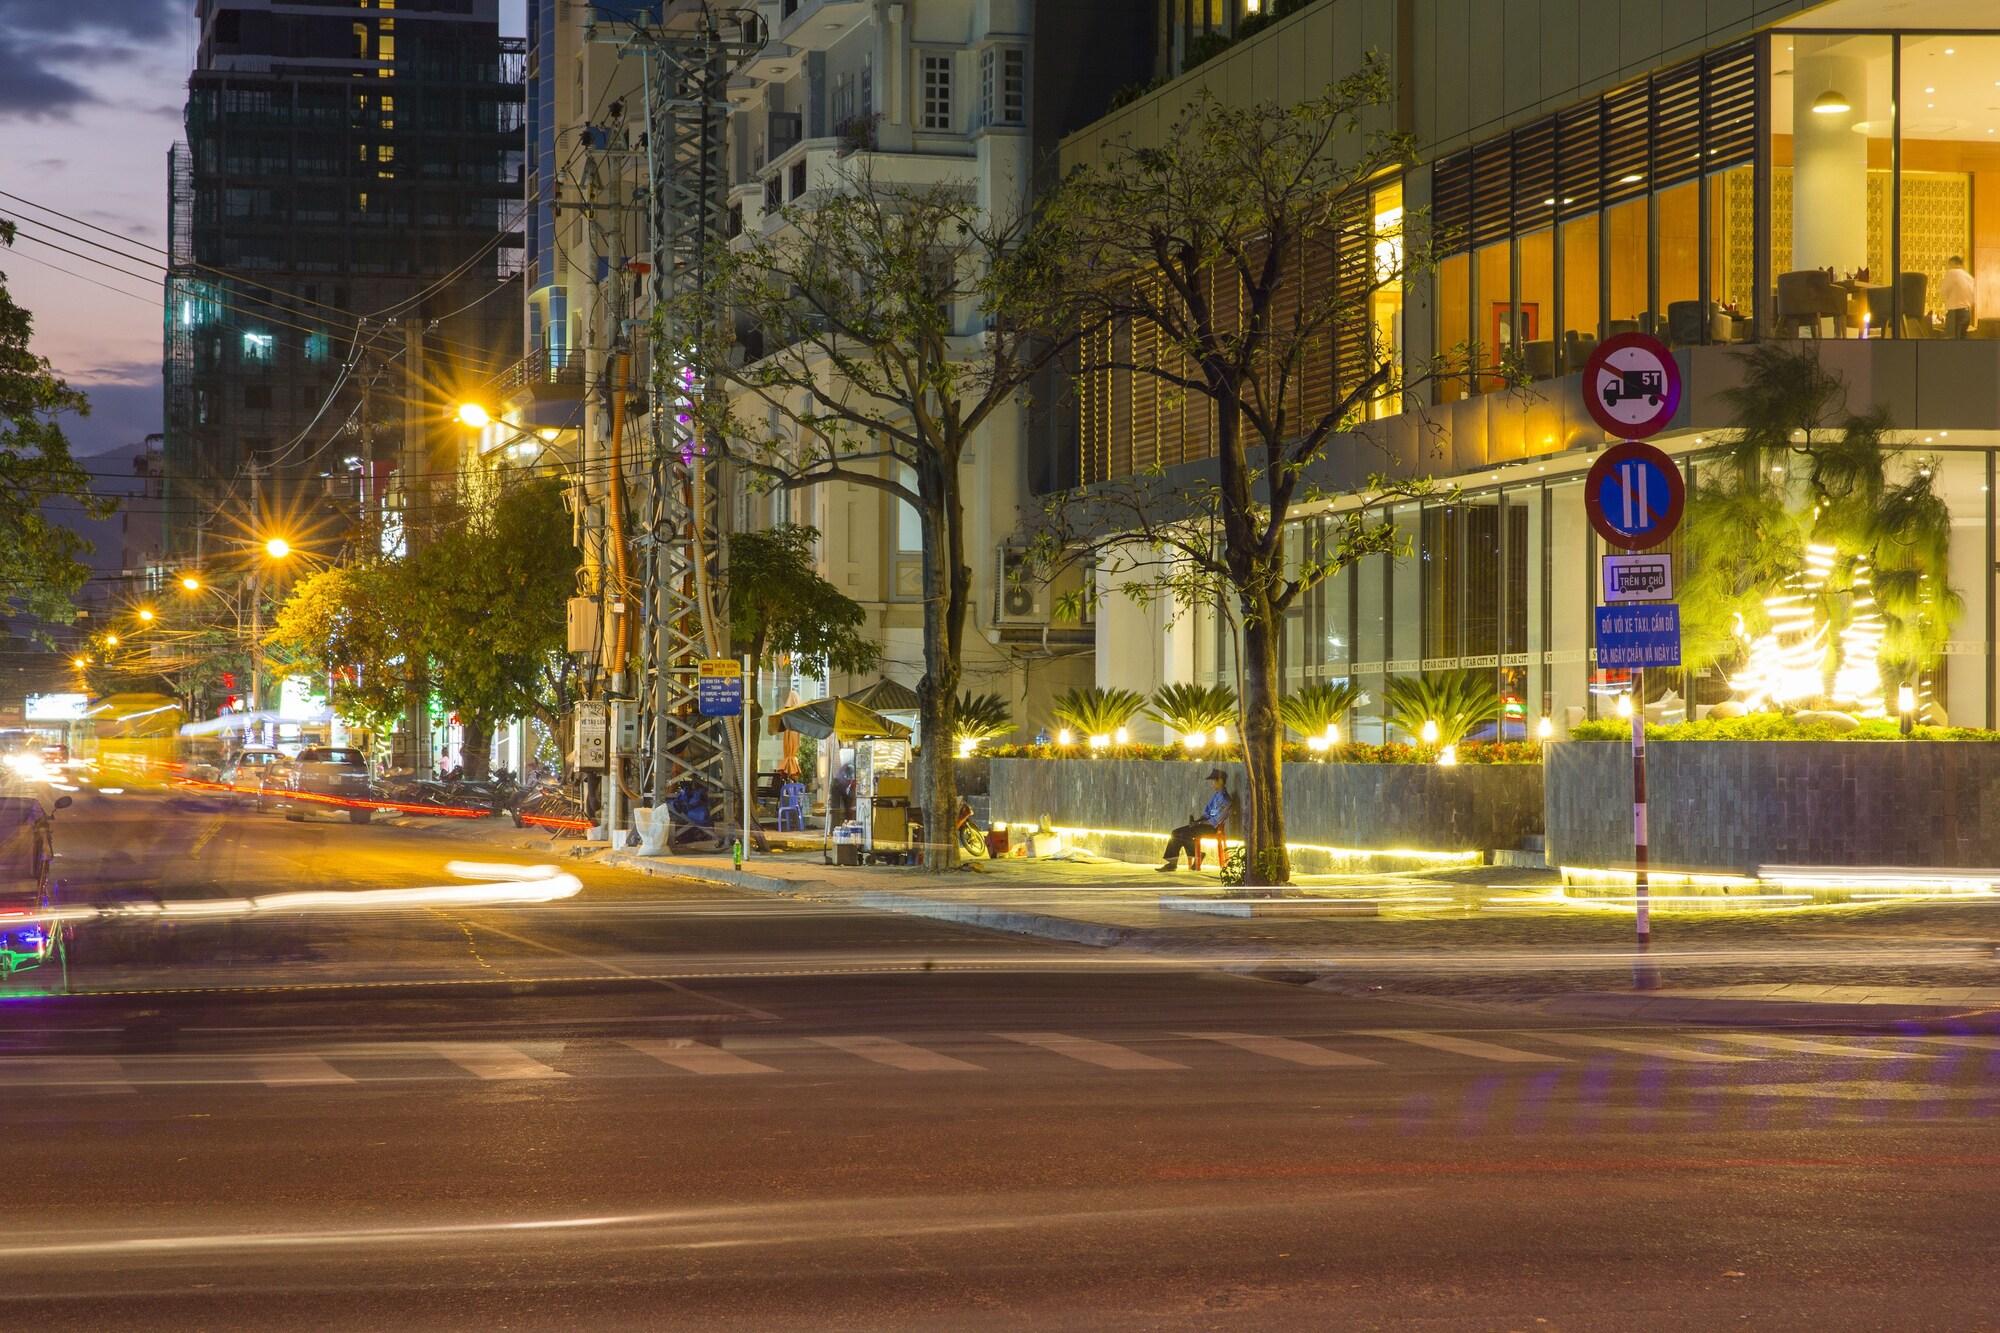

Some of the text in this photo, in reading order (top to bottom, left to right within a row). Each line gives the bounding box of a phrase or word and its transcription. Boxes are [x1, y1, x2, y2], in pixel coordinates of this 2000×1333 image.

[1642, 372, 1660, 385] 5T
[1620, 575, 1639, 586] TRÊN
[1641, 576, 1647, 586] 9
[1624, 617, 1633, 633] XE
[1651, 611, 1665, 633] CẤM
[1609, 644, 1625, 663] NGÀY
[1644, 643, 1653, 662] VÀ
[1654, 643, 1670, 662] NGÀY
